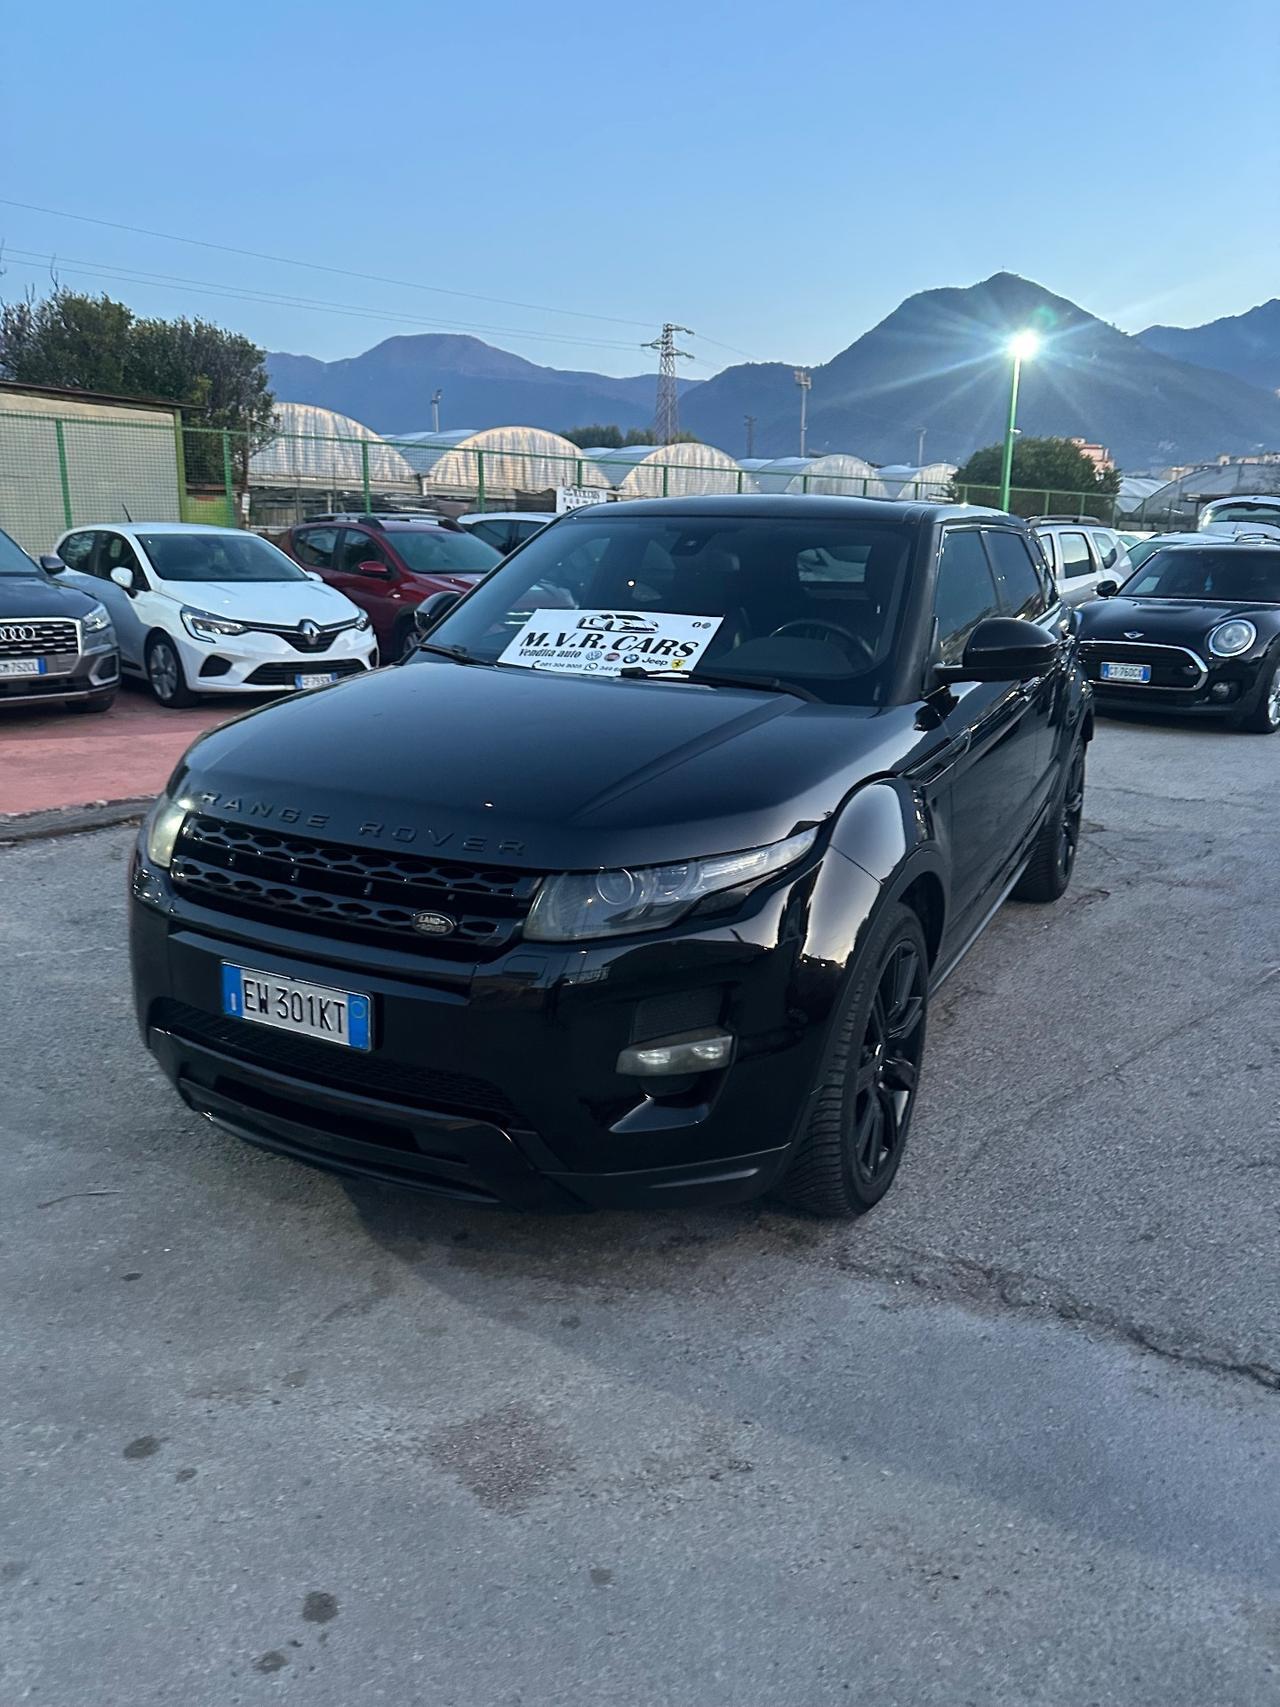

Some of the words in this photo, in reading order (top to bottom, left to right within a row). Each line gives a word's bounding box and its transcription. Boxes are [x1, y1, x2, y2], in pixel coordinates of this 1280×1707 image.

[519, 648, 556, 657] Vendita
[557, 650, 582, 658] auto
[642, 657, 668, 666] Jeep
[202, 791, 330, 829] RANGE
[360, 821, 525, 857] ROVER
